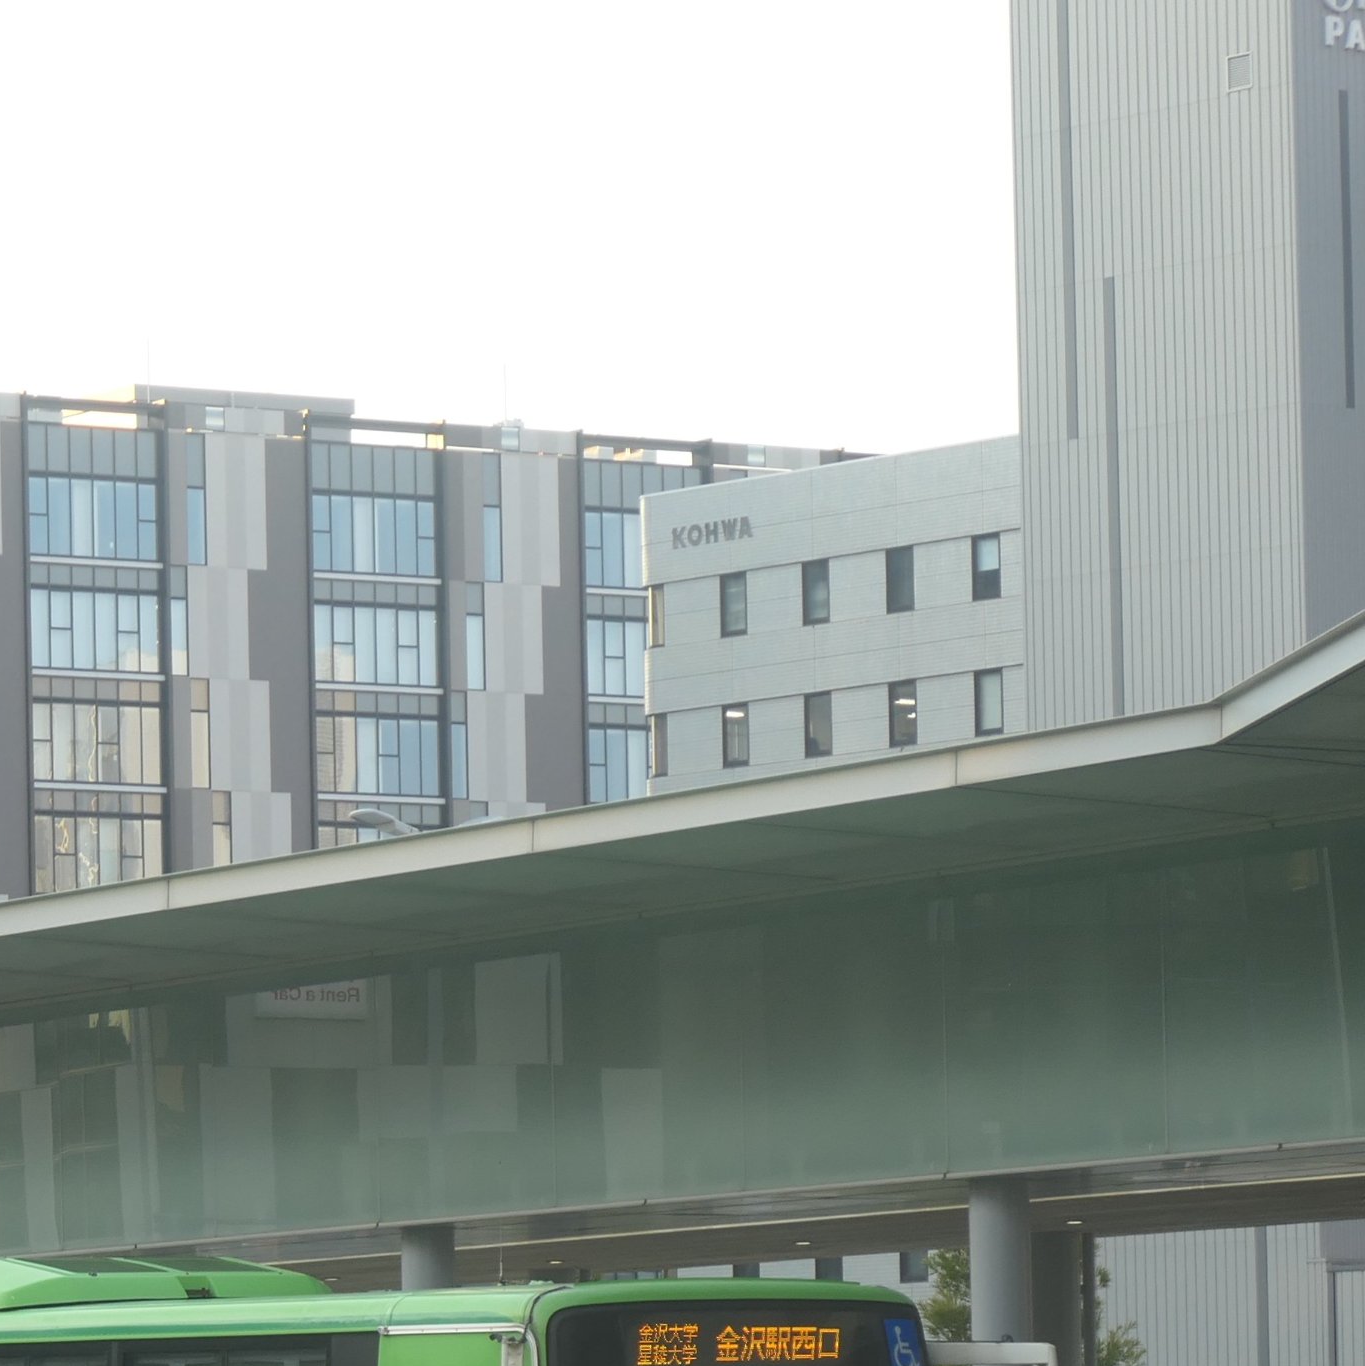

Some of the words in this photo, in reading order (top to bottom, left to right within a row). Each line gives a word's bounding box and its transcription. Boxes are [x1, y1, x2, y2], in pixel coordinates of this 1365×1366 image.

[672, 516, 753, 550] KOHWA
[638, 1323, 699, 1344] 金沢大学
[716, 1325, 840, 1362] 金沢駅西口
